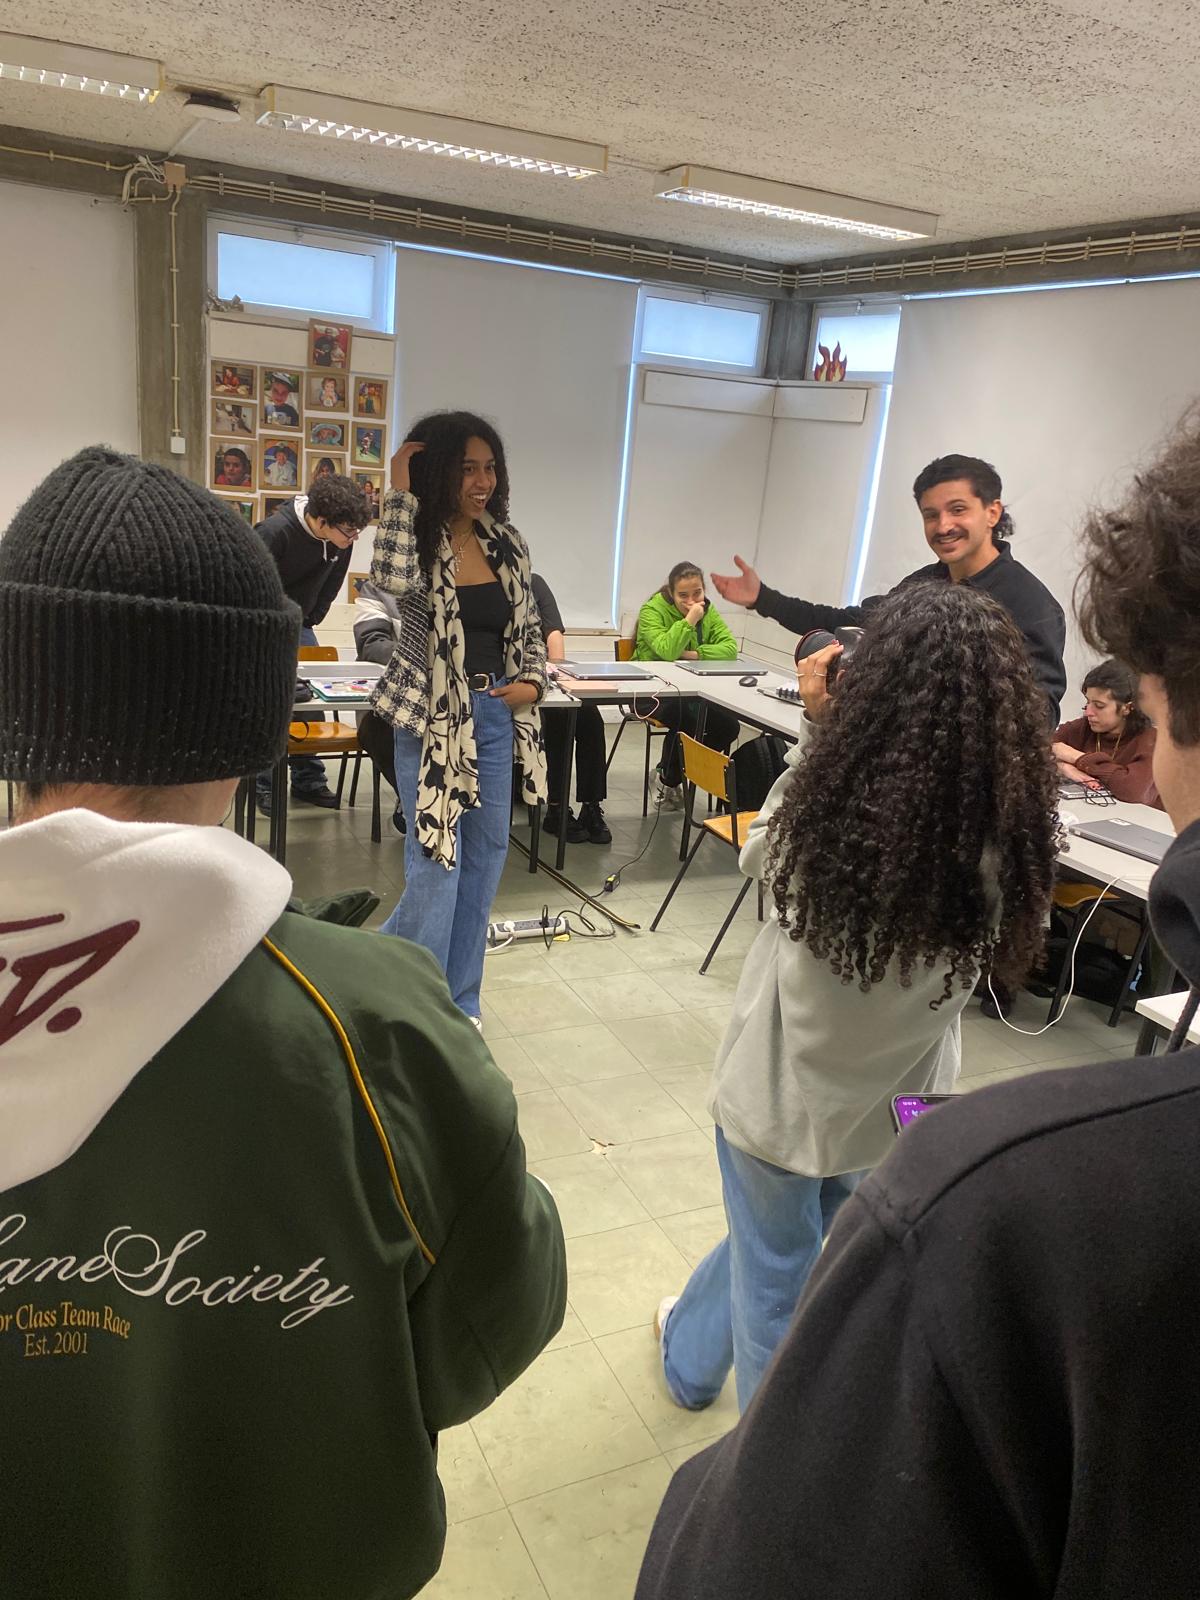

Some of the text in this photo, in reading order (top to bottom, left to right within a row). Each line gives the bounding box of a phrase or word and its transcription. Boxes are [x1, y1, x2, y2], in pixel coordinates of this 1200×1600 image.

[104, 1226, 354, 1329] Society
[16, 1304, 57, 1330] Class
[61, 1302, 100, 1328] Team
[103, 1305, 131, 1339] Race
[24, 1331, 88, 1357] Est. 2001
